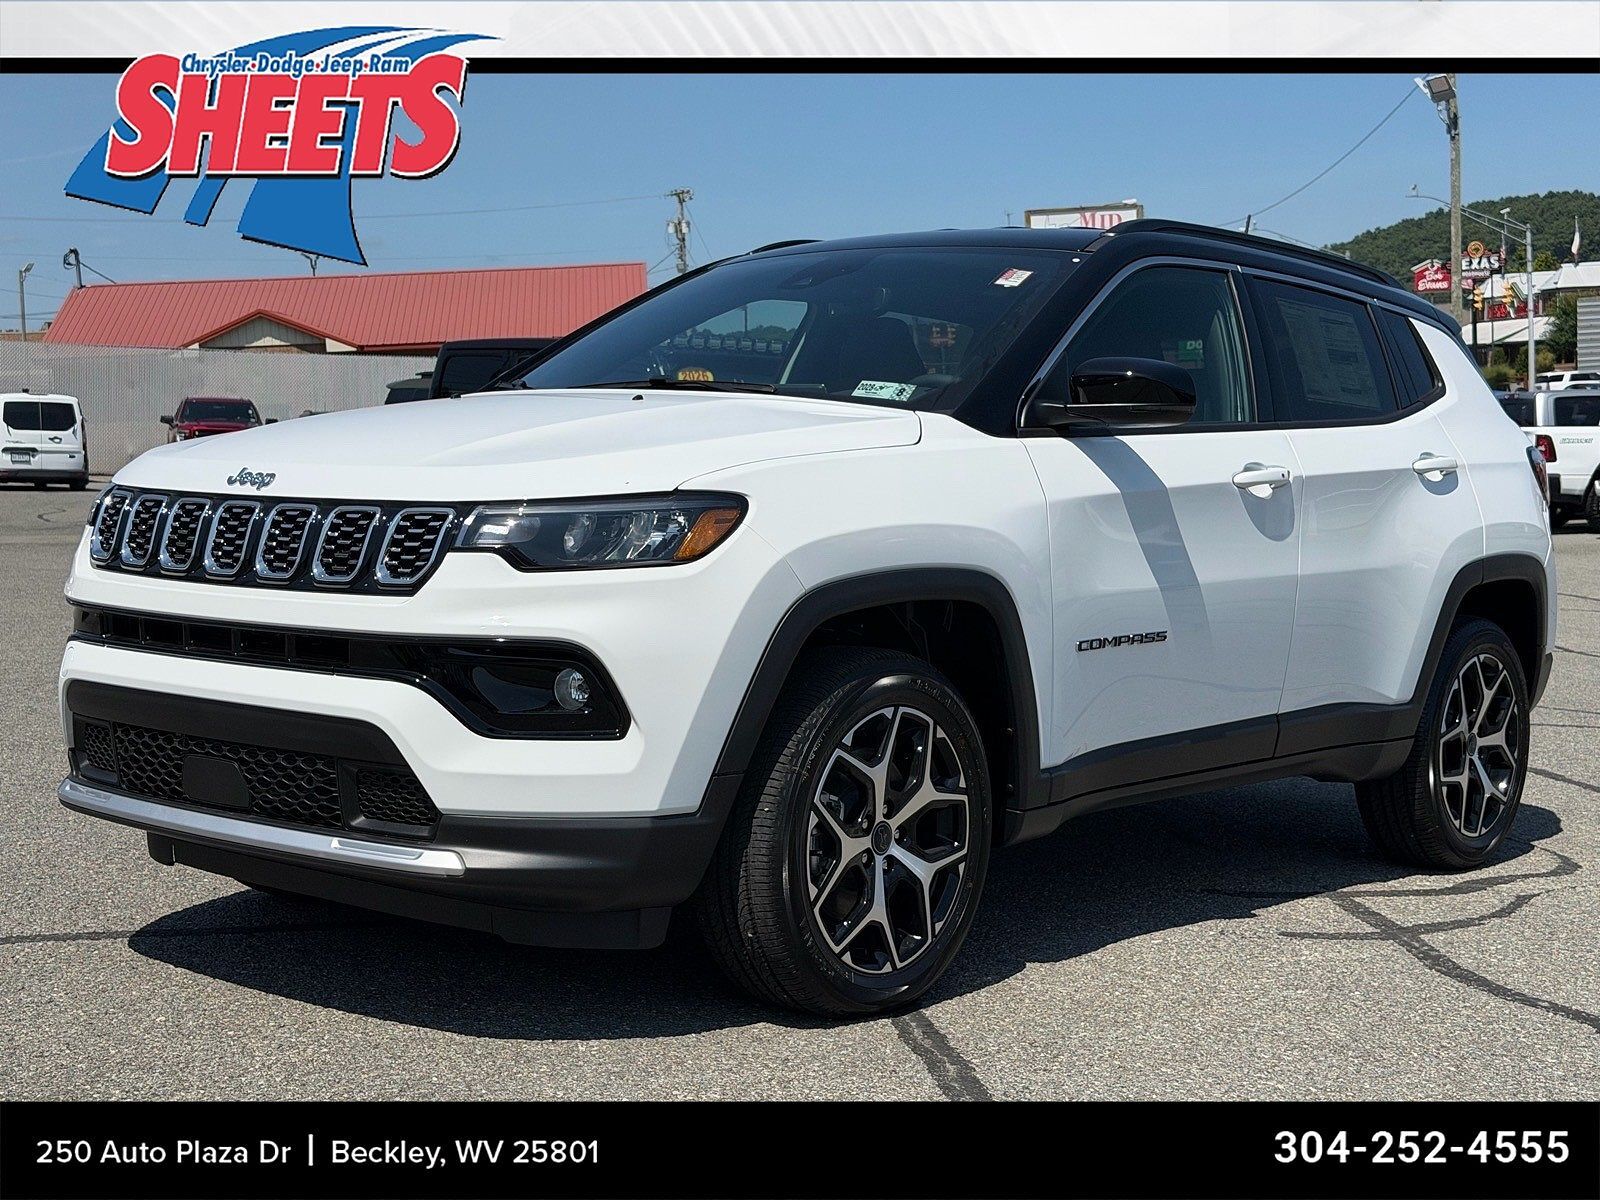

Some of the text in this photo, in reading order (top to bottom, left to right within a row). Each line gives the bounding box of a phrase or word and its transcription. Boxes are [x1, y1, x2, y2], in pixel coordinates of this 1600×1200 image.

[1461, 256, 1499, 270] EXAS
[1423, 270, 1444, 280] Bob
[896, 387, 906, 397] 8
[227, 467, 276, 491] Jeep
[1076, 630, 1168, 652] COMPASS
